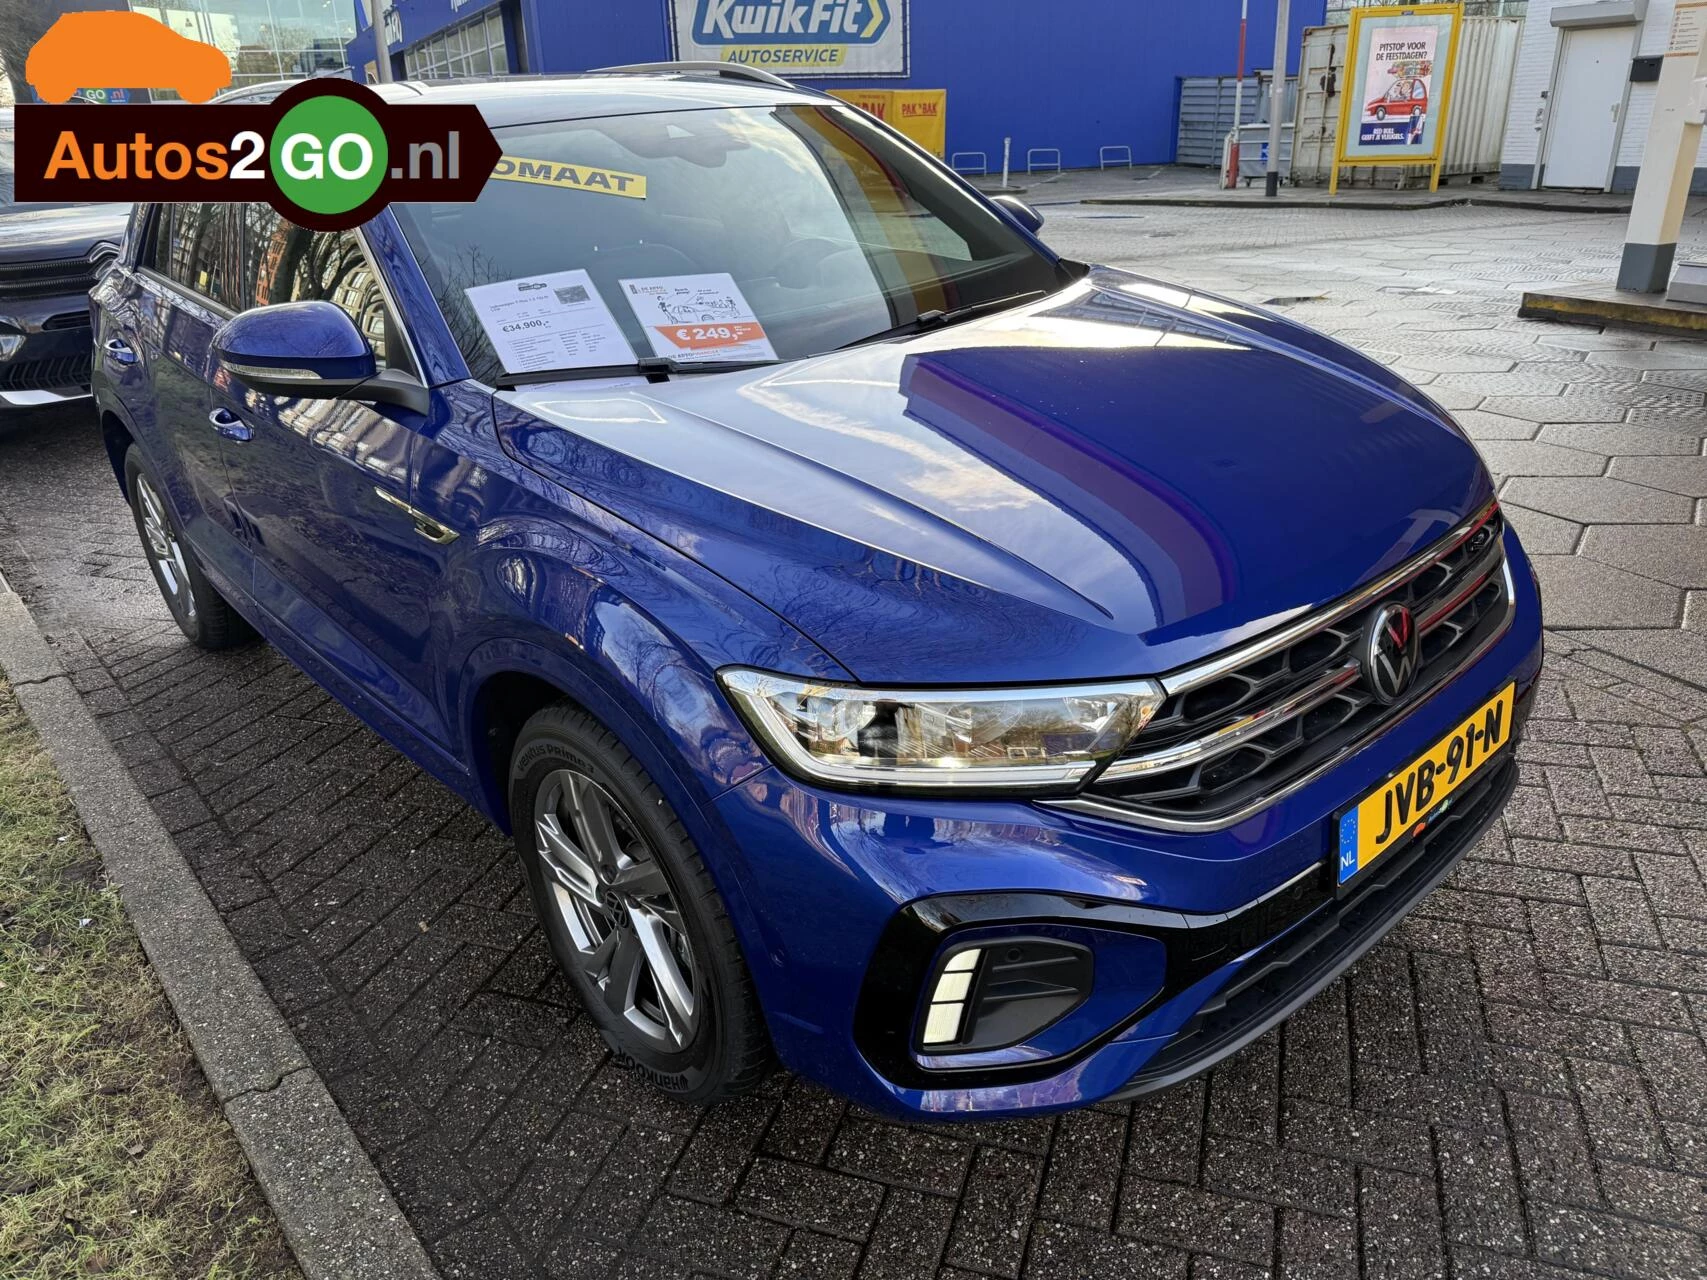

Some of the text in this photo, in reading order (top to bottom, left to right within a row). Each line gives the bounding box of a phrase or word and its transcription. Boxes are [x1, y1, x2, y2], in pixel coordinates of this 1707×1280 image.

[1379, 41, 1427, 52] PITSTOP VOOR
[728, 48, 839, 63] AUTOSERVICE
[1376, 51, 1428, 61] DE FEESTDAGEN?
[901, 103, 917, 115] PAK
[922, 102, 937, 113] BAK
[676, 328, 691, 341] €
[1375, 700, 1503, 845] JVB-91-N
[1340, 851, 1355, 871] NL
